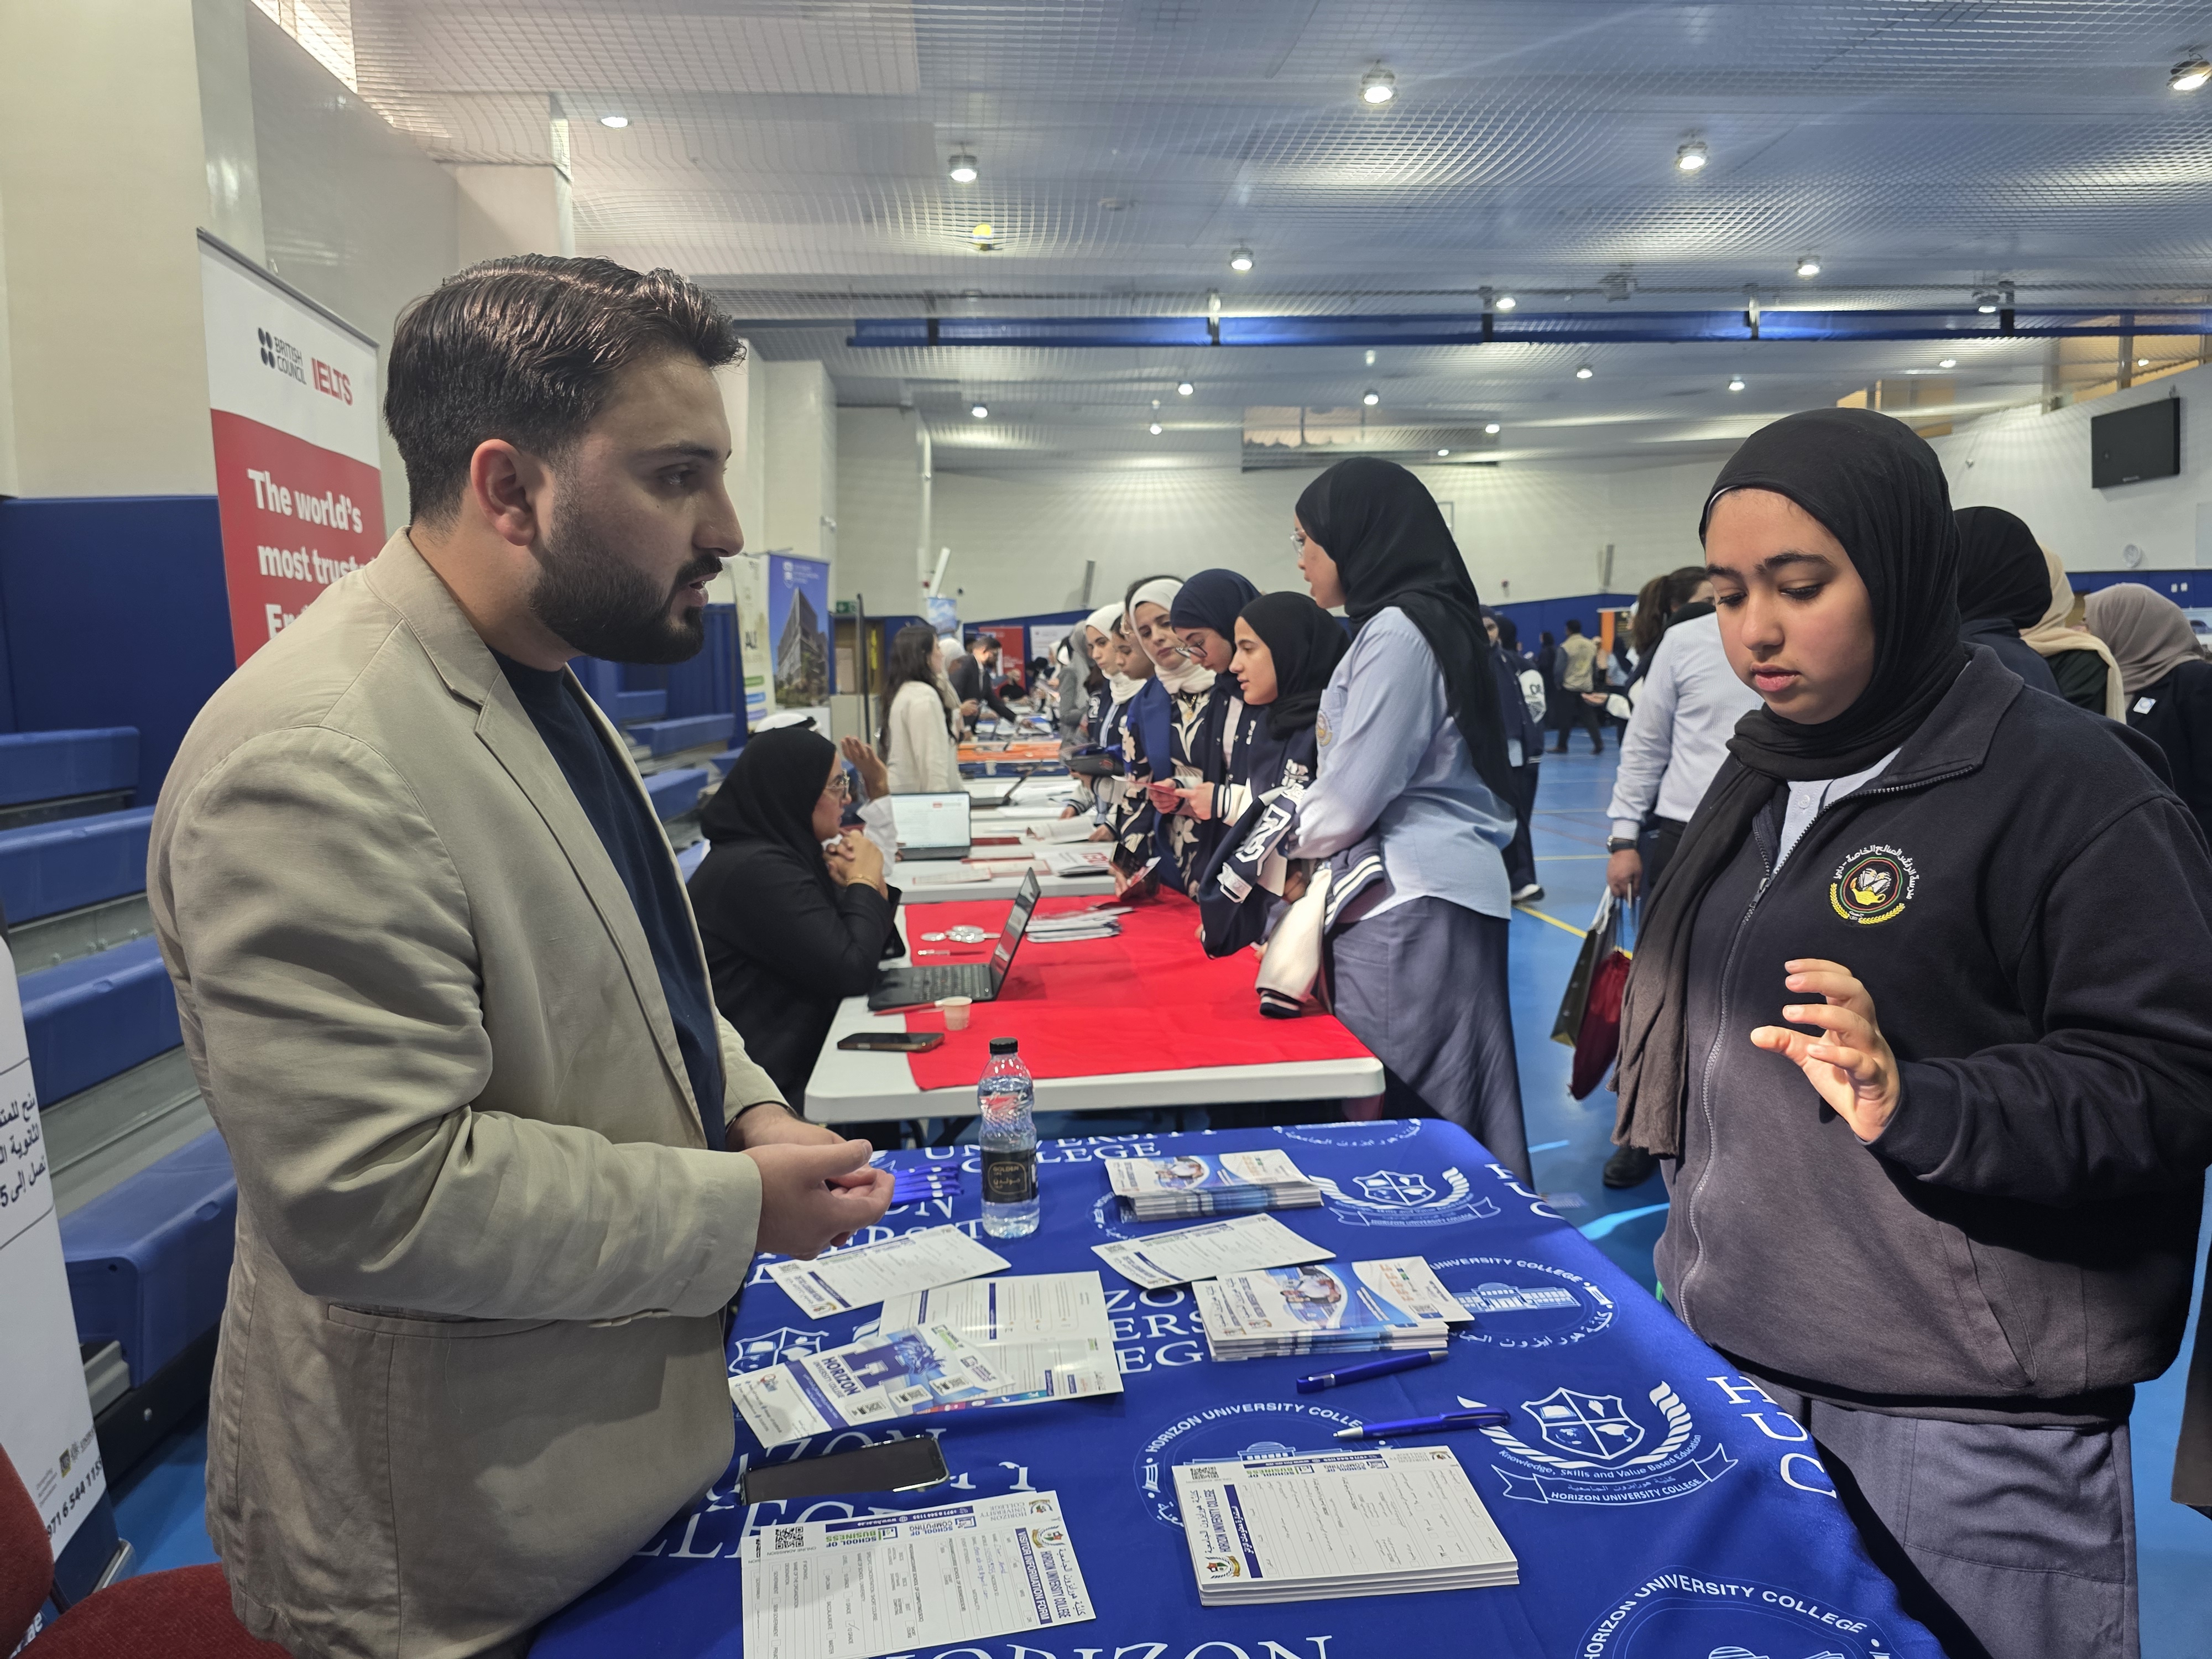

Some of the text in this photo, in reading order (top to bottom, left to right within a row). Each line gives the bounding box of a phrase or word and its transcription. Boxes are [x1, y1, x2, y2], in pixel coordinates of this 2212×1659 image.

[274, 336, 304, 366] BRITISH
[277, 356, 307, 385] COUNCIL
[311, 357, 353, 406] IELTS
[247, 468, 363, 534] The world's
[257, 545, 380, 585] most trust
[11, 1123, 40, 1160] لثانوية
[1430, 1256, 1583, 1283] UNIVERSITY COLLEGE
[821, 1355, 862, 1396] HORIZON
[1145, 1402, 1364, 1454] HORIZON UNIVERSITY COLLE
[1498, 1433, 1703, 1479] Knowledge, Skills and Value Based Education
[1550, 1477, 1704, 1503] HORIZON UNIVERSITY COLLEGE
[825, 1530, 877, 1543] BUSINESS
[840, 1536, 877, 1546] SCHOOL
[908, 1520, 953, 1532] COMPUTING
[924, 1526, 953, 1535] SCHOOL
[1016, 1531, 1050, 1620] VISITOR INFORMATION FORM
[1045, 1569, 1065, 1597] UNIVERSITY
[1053, 1597, 1072, 1619] COLLEGE
[1583, 1573, 1869, 1659] HORIZON UNIVERSITY COLLEGE
